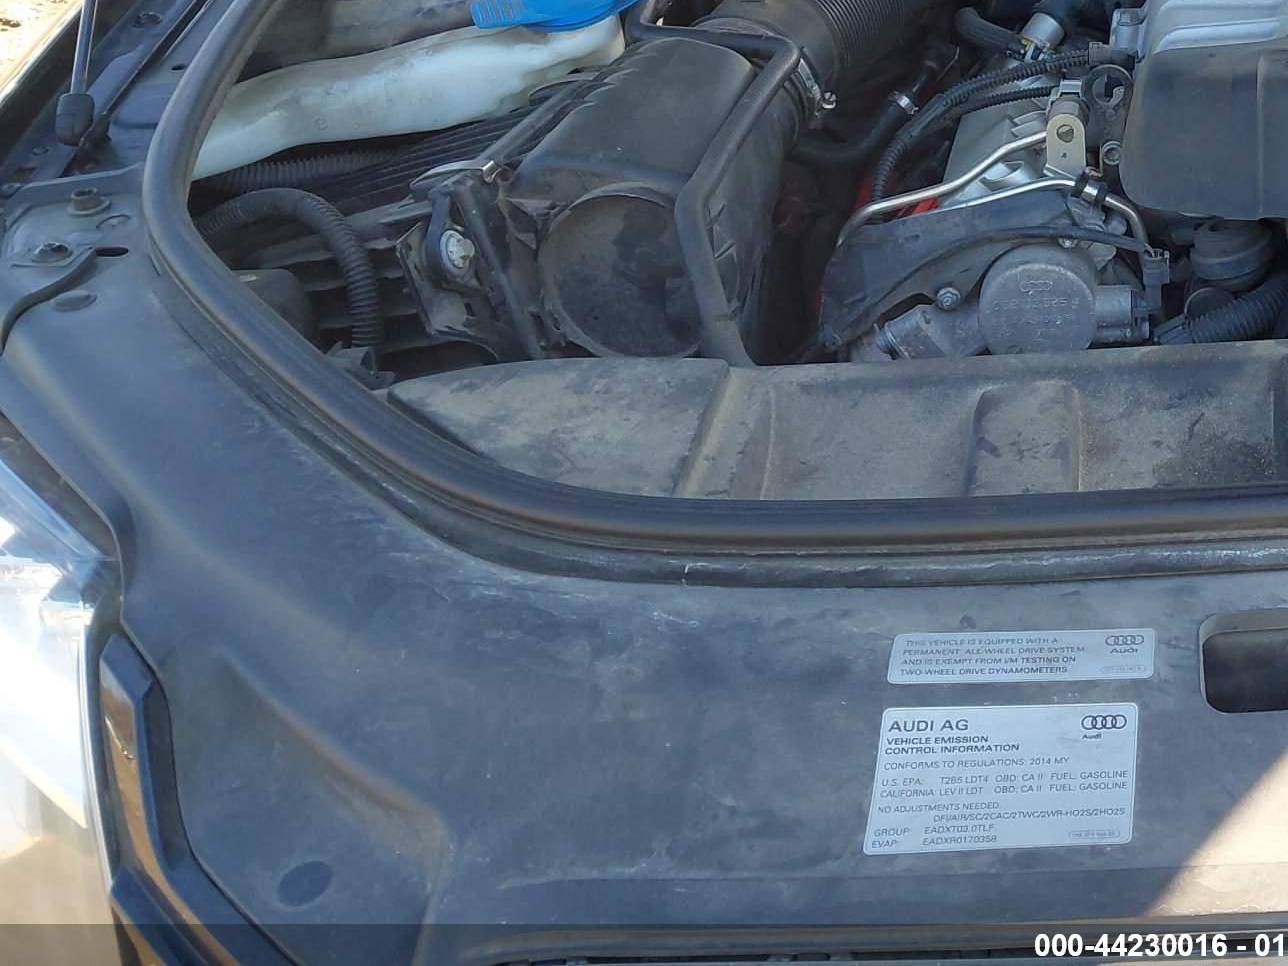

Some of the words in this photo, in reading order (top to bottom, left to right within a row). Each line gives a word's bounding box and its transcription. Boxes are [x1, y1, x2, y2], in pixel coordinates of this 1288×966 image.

[905, 639, 925, 647] THIS
[928, 638, 964, 646] VEHICLE
[967, 638, 976, 646] IS
[979, 637, 1023, 646] EQUIPPED
[1026, 637, 1048, 645] WITH
[903, 648, 960, 656] PERMANENT
[901, 658, 922, 666] AND
[974, 657, 1002, 665] FROM
[1021, 656, 1060, 664] TESTING
[900, 668, 957, 676] TWO-WHEEL
[988, 666, 1068, 675] DYNAMOMETERS
[888, 719, 935, 733] AUDI
[939, 718, 969, 732] AG
[886, 737, 932, 746] VEHICLE
[934, 735, 990, 745] EMISSION
[1081, 732, 1102, 740] Audi
[884, 746, 938, 755] CONTROL
[940, 743, 1020, 754] INFORMATION
[883, 760, 940, 771] CONFORMS
[942, 760, 955, 769] TO
[1029, 757, 1051, 766] 2014
[1053, 756, 1070, 765] MY
[965, 775, 989, 784] LDT4
[1021, 773, 1035, 782] CA
[1080, 770, 1129, 780] GASOLINE
[939, 787, 956, 796] LEV
[965, 786, 985, 795] LDT
[1020, 784, 1034, 793] CA
[1079, 781, 1129, 791] GASOLINE
[877, 805, 892, 814] NO
[894, 803, 960, 813] ADJUSTMENTS
[922, 834, 998, 846] EADXR0170358
